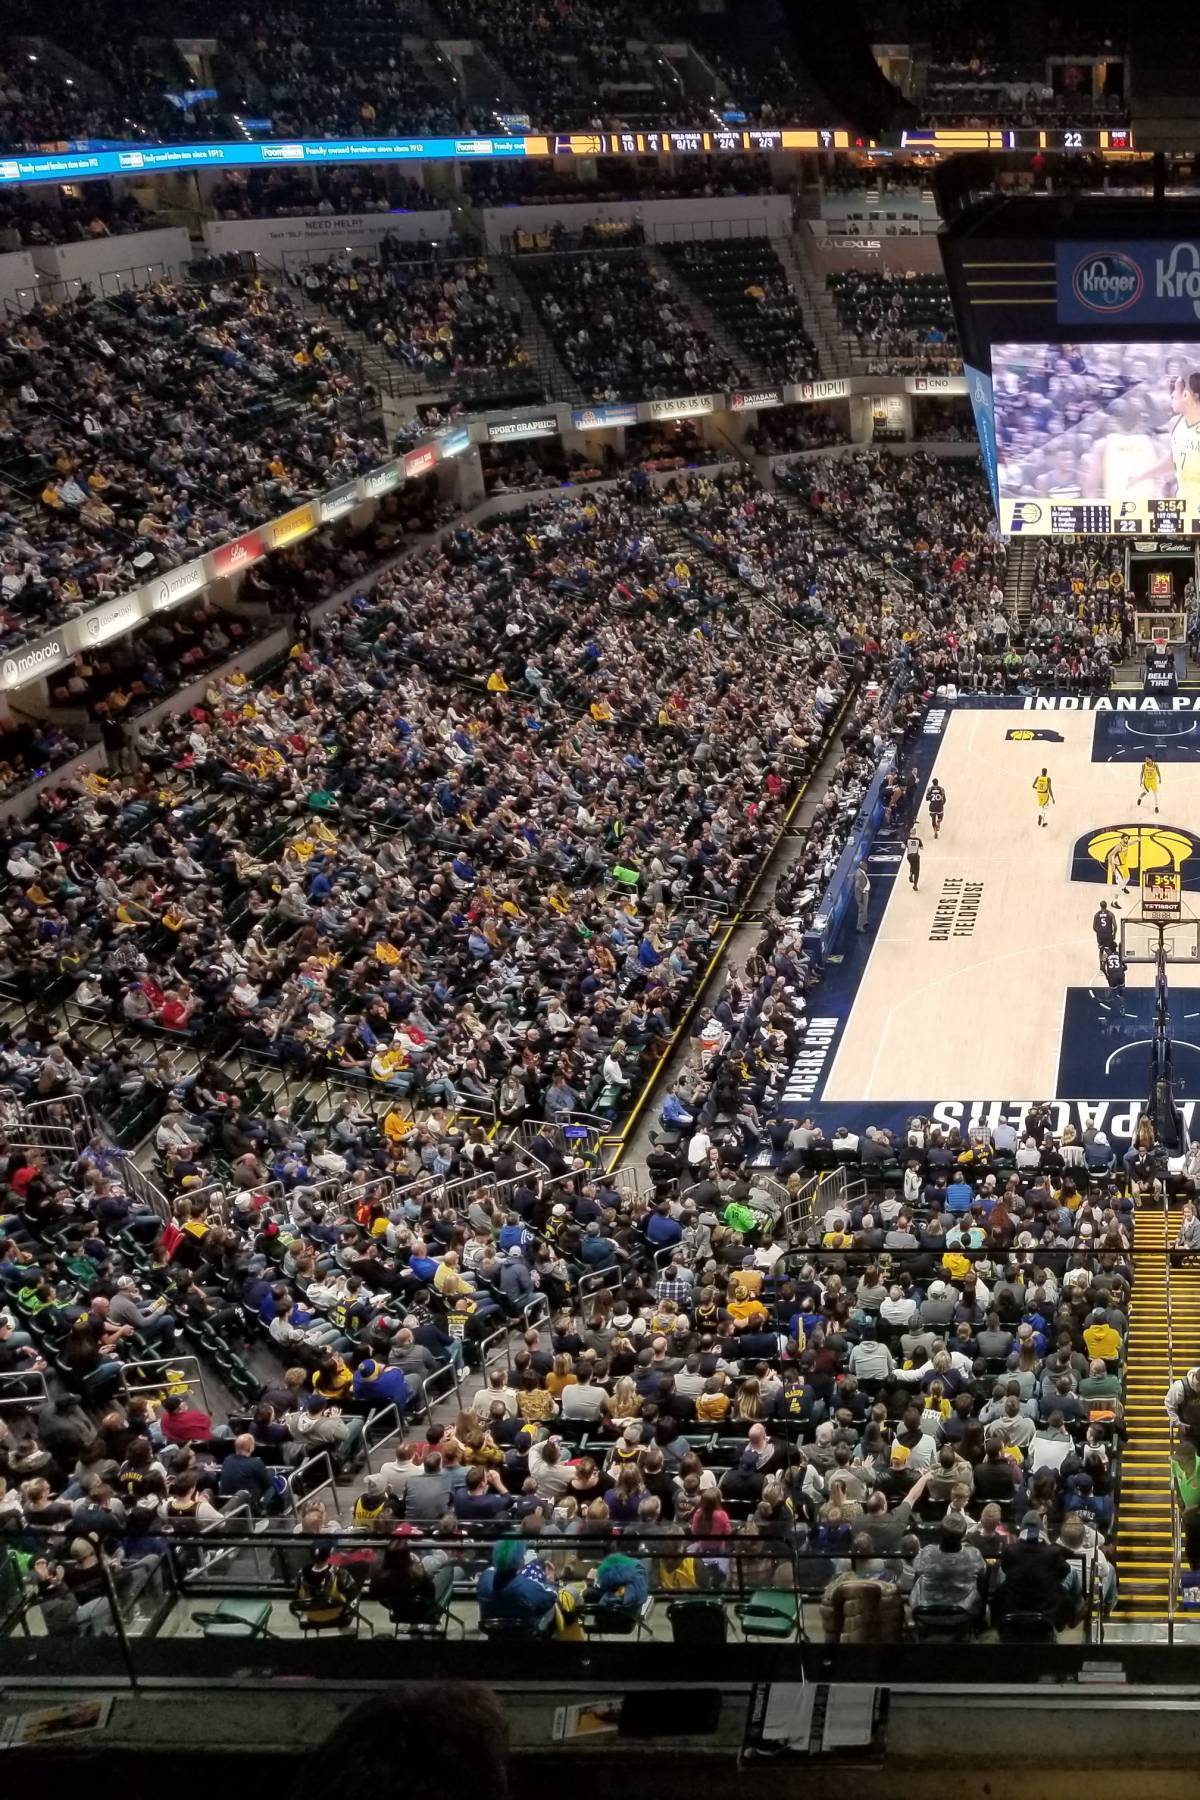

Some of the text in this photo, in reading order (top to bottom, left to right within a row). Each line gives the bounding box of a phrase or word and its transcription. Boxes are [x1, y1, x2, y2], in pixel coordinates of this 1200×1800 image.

[720, 139, 734, 149] 2/4
[758, 138, 774, 148] 2/3
[824, 138, 830, 147] 7
[1064, 132, 1082, 147] 22
[1113, 138, 1126, 147] 23
[622, 141, 634, 151] 10
[650, 141, 657, 150] 4
[676, 140, 697, 150] 8/14
[306, 147, 326, 157] Family
[305, 220, 332, 230] NEED
[834, 240, 881, 248] LEXUS
[1083, 261, 1136, 304] Kroger
[930, 380, 949, 388] CNO
[816, 381, 845, 398] IUPUI
[744, 392, 778, 402] DATABANK
[517, 420, 557, 432] GRAPHICS
[1180, 452, 1187, 470] 7
[1158, 501, 1185, 512] 3:54
[1120, 520, 1136, 532] 22
[1160, 542, 1192, 552] Cadillac
[170, 570, 199, 592] ambrose
[1154, 582, 1168, 593] 23
[18, 641, 60, 672] motorola
[1024, 696, 1160, 710] INDIANA
[1154, 875, 1176, 884] 3:54
[928, 878, 964, 941] BANKERS LIFE
[952, 882, 984, 936] FIELDHOUSE
[1100, 918, 1107, 926] 5
[1108, 960, 1120, 968] 33
[781, 1018, 839, 1102] PACERS.COM
